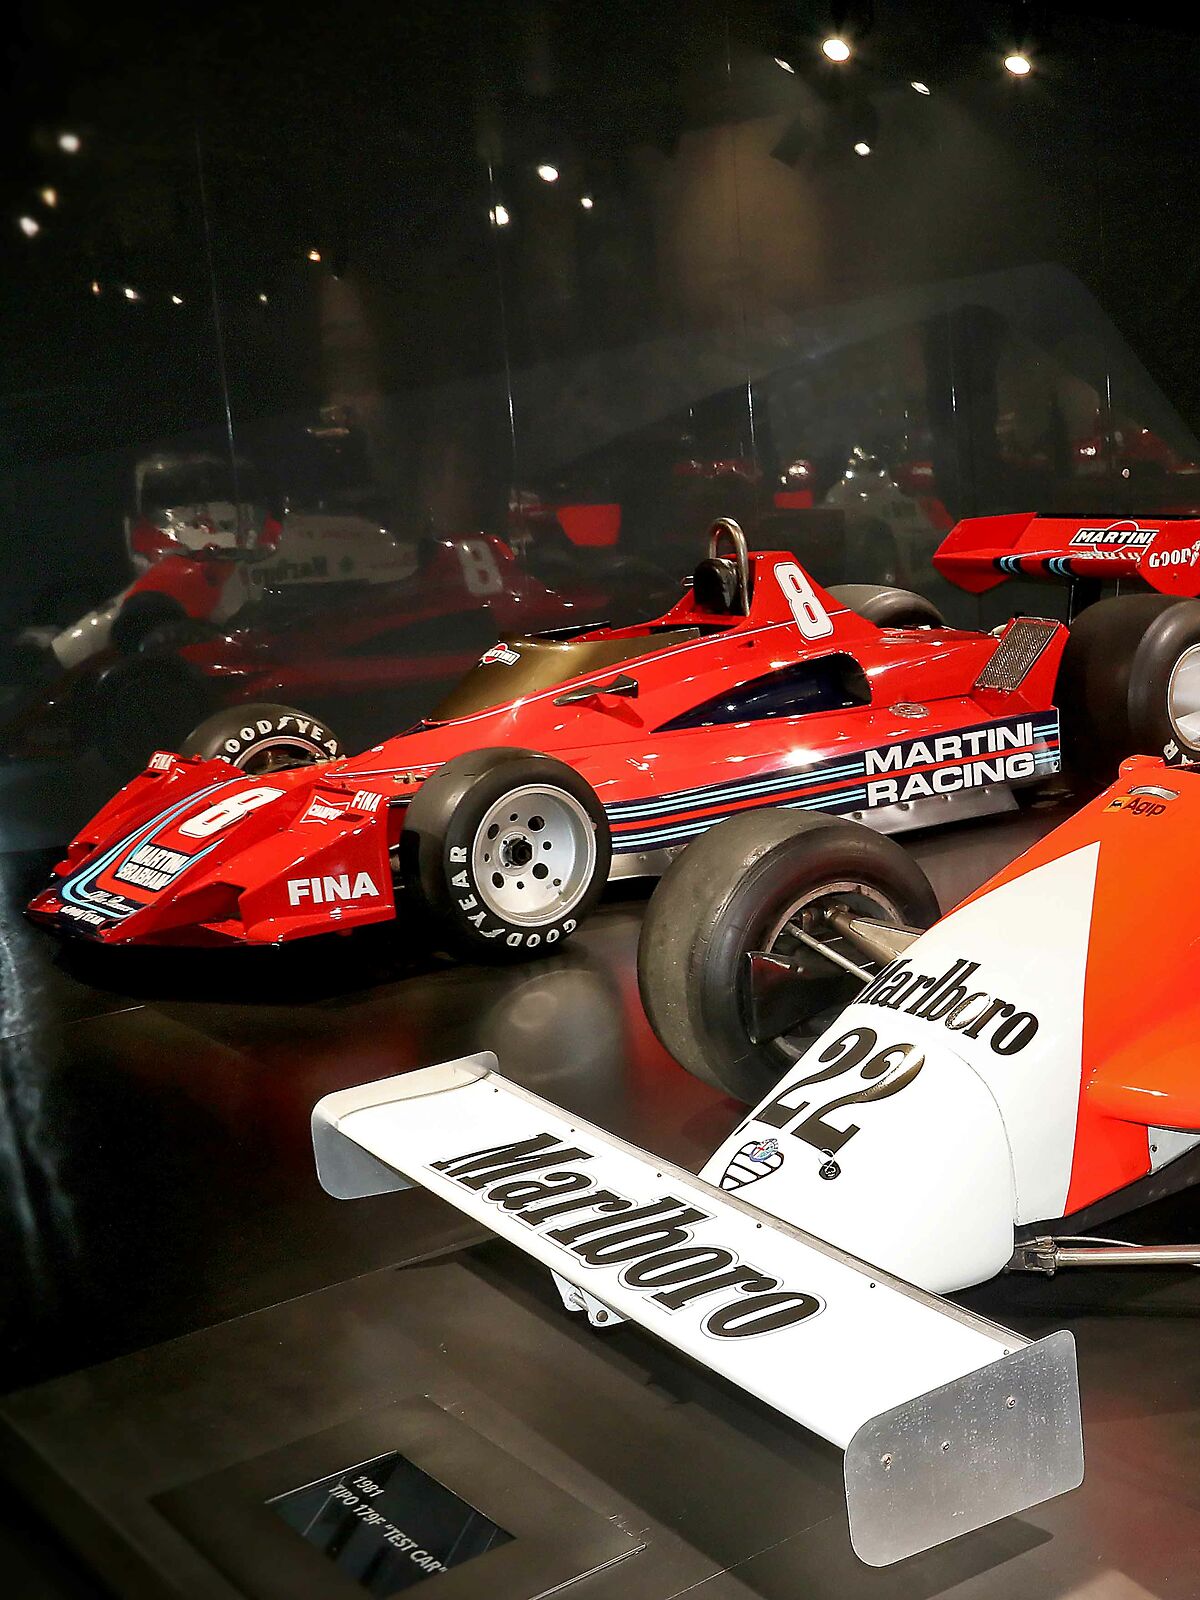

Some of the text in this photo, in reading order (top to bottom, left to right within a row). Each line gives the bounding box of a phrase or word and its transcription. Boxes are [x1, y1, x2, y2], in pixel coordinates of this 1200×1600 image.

[774, 562, 834, 640] 8
[865, 722, 1034, 775] MARTINI
[351, 790, 382, 812] FINA
[867, 752, 1035, 807] RACING
[178, 786, 287, 838] 8
[1122, 797, 1166, 816] Agip
[287, 872, 379, 906] FINA
[752, 1027, 925, 1153] 22
[430, 1132, 821, 1338] Marlboro
[328, 1484, 359, 1506] TIPO
[353, 1504, 386, 1525] 179F
[353, 1476, 384, 1498] 1981
